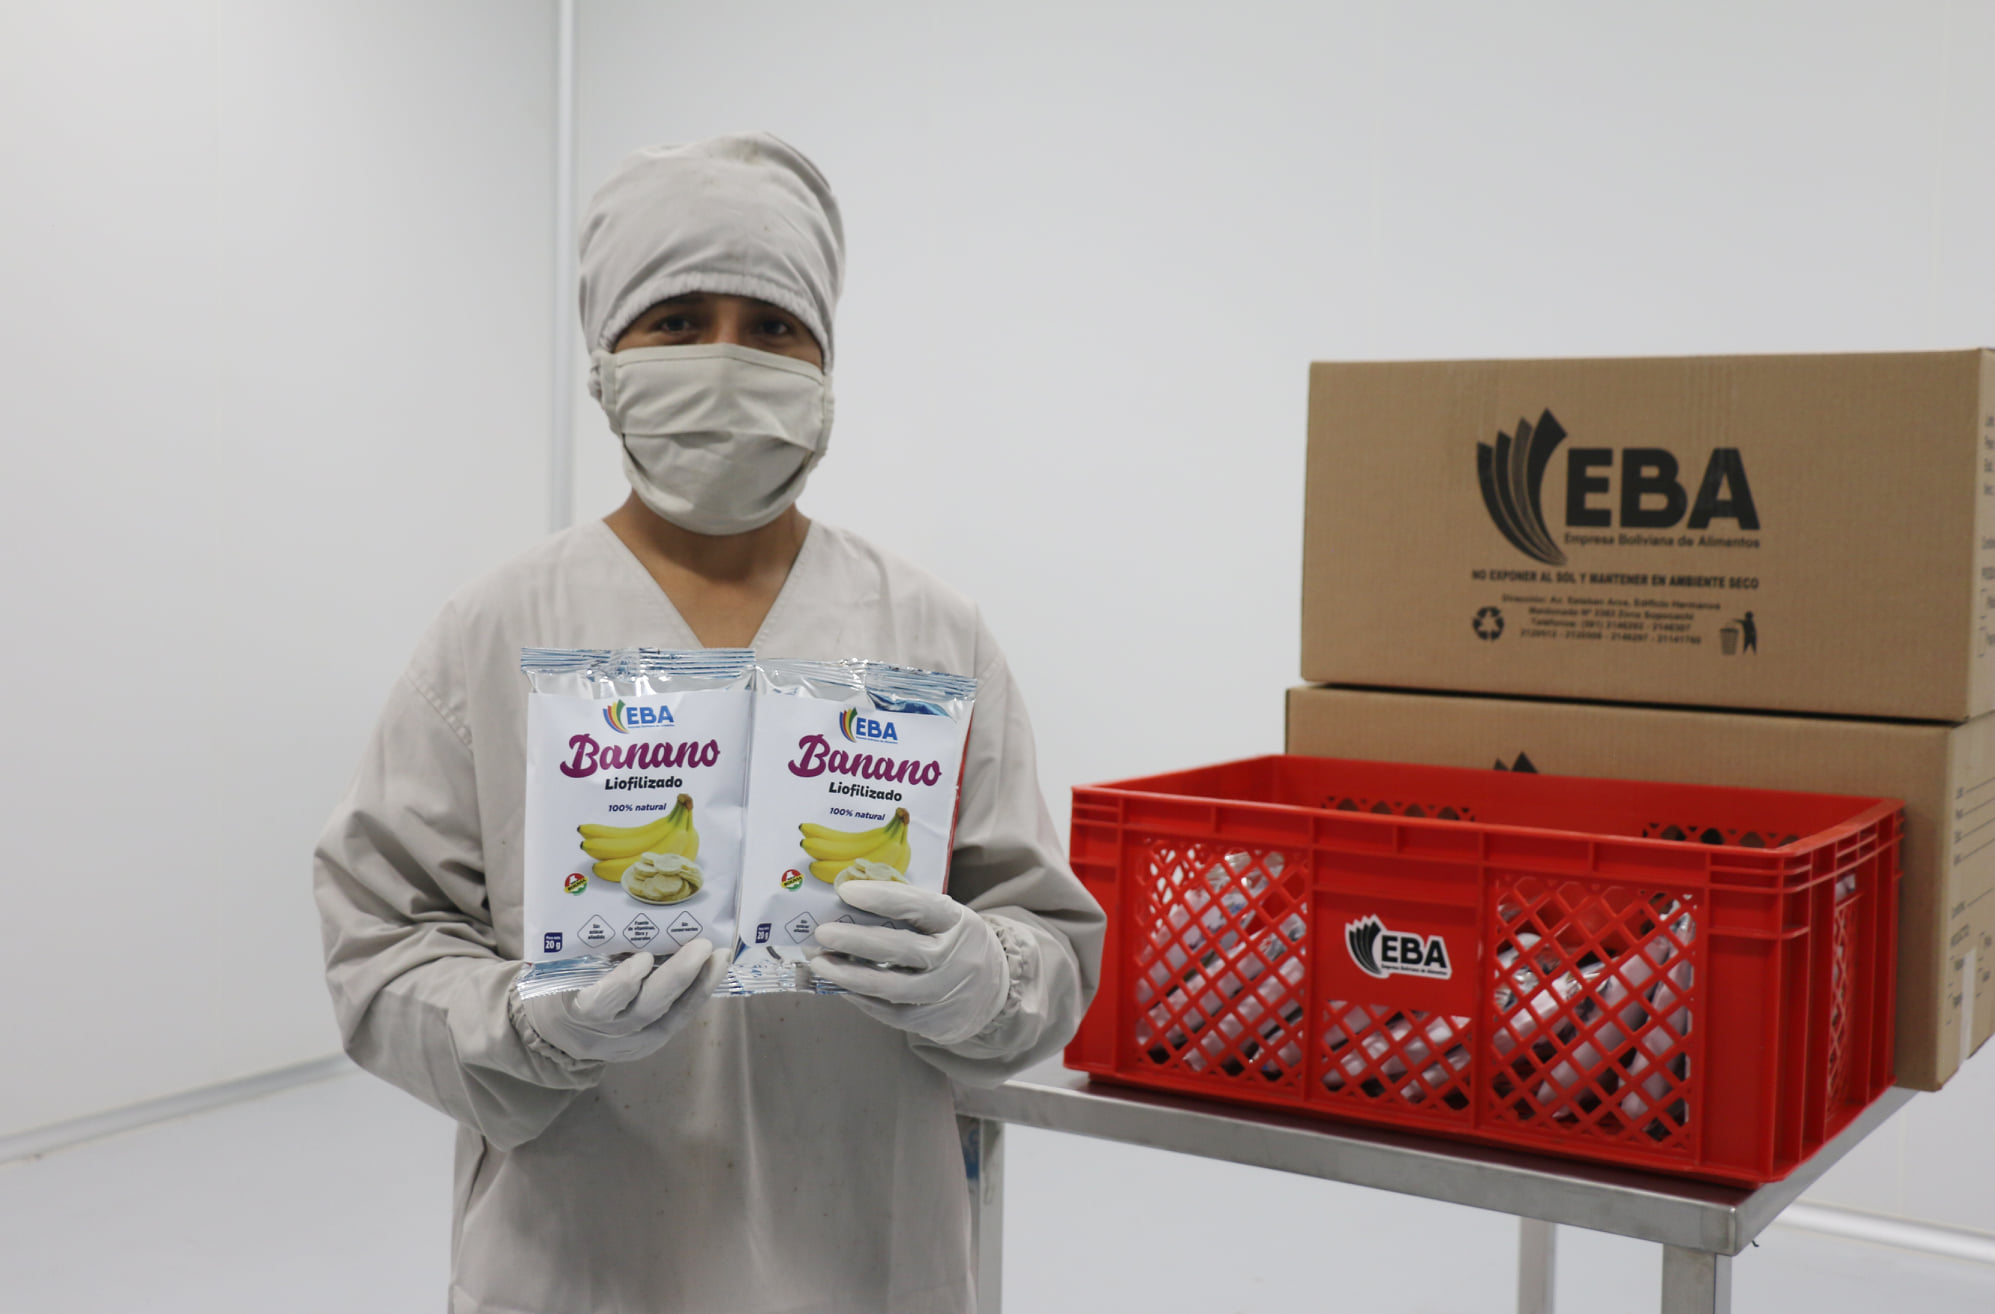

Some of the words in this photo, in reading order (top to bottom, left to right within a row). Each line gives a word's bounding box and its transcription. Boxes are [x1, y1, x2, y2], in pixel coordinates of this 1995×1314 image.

[1565, 448, 1760, 530] EBA
[1564, 533, 1614, 545] Empresa
[1619, 533, 1673, 546] Boliviana
[1678, 535, 1694, 547] de
[1697, 535, 1760, 548] Alimentos
[1472, 570, 1487, 580] NO
[1489, 570, 1537, 581] EXPONER
[1540, 571, 1552, 582] AL
[1556, 571, 1576, 583] SOL
[1580, 572, 1586, 583] Y
[1590, 572, 1648, 585] MANTENER
[1651, 574, 1666, 586] EN
[1669, 575, 1725, 588] AMBIENTE
[1728, 576, 1759, 589] SECO
[626, 705, 674, 725] EBA
[856, 717, 898, 741] EBA
[559, 733, 720, 778] Banano
[787, 734, 942, 786] Banano
[605, 776, 683, 791] Liofilizado
[828, 782, 902, 801] Liofilizado
[608, 804, 633, 812] 100%
[635, 803, 667, 812] natural
[829, 807, 853, 817] 100%
[854, 811, 886, 821] natural
[545, 940, 555, 949] 20
[555, 941, 561, 950] g
[757, 931, 764, 940] 20
[1382, 935, 1447, 968] EBA
